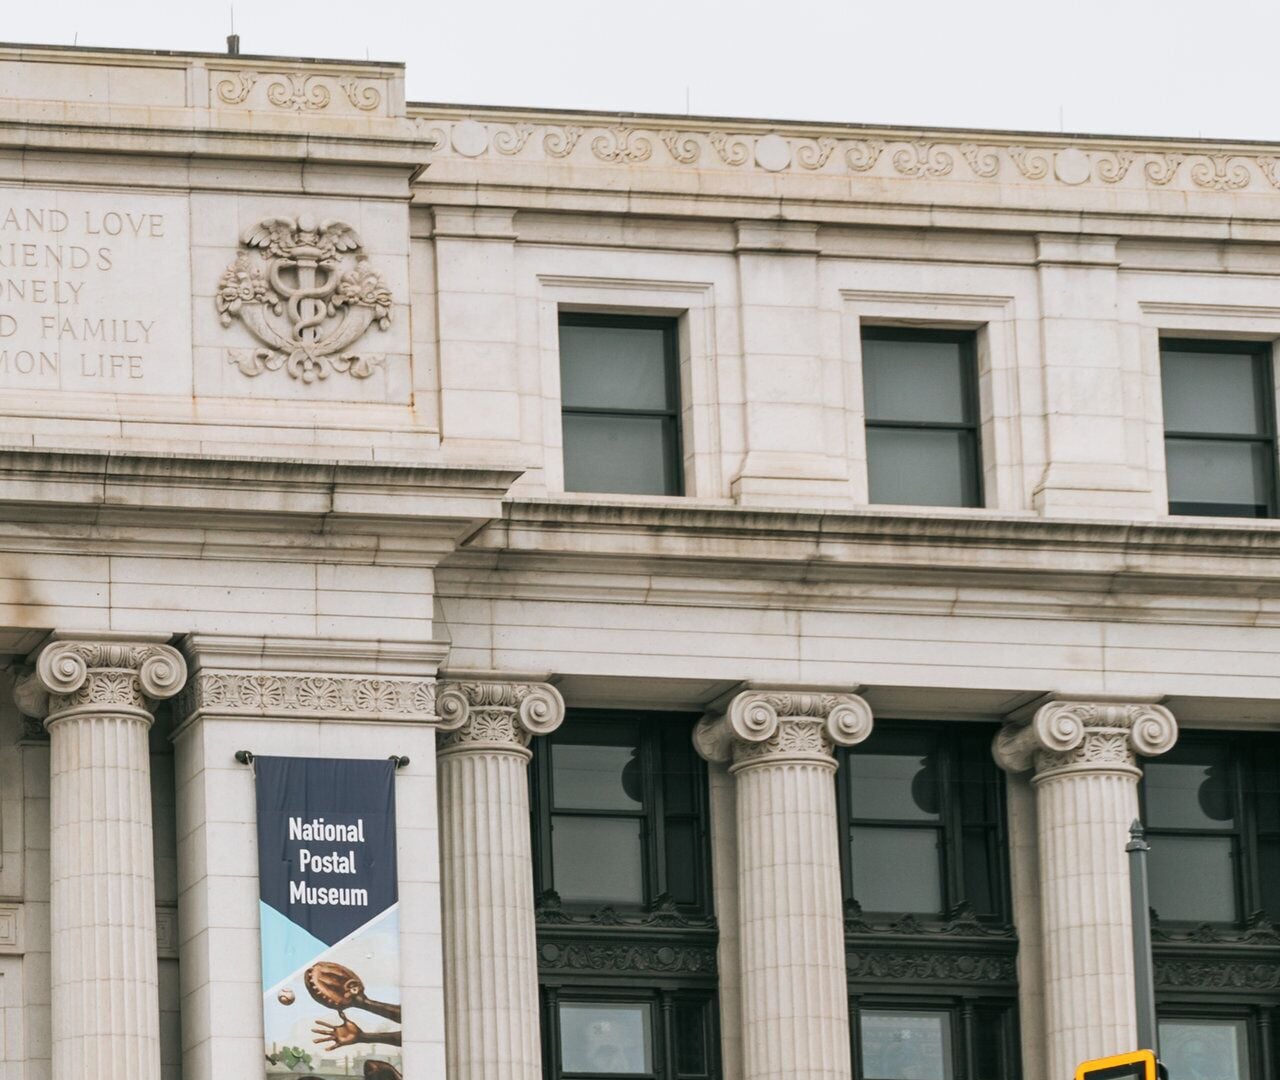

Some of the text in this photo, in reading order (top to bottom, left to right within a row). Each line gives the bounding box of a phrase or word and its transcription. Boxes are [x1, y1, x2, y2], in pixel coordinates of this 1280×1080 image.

[0, 207, 70, 233] AND
[85, 211, 165, 238] LOVE
[40, 316, 156, 344] FAMILY
[80, 353, 145, 380] LIFE
[289, 817, 365, 843] National
[299, 849, 357, 874] Postal
[289, 880, 368, 906] Museum
